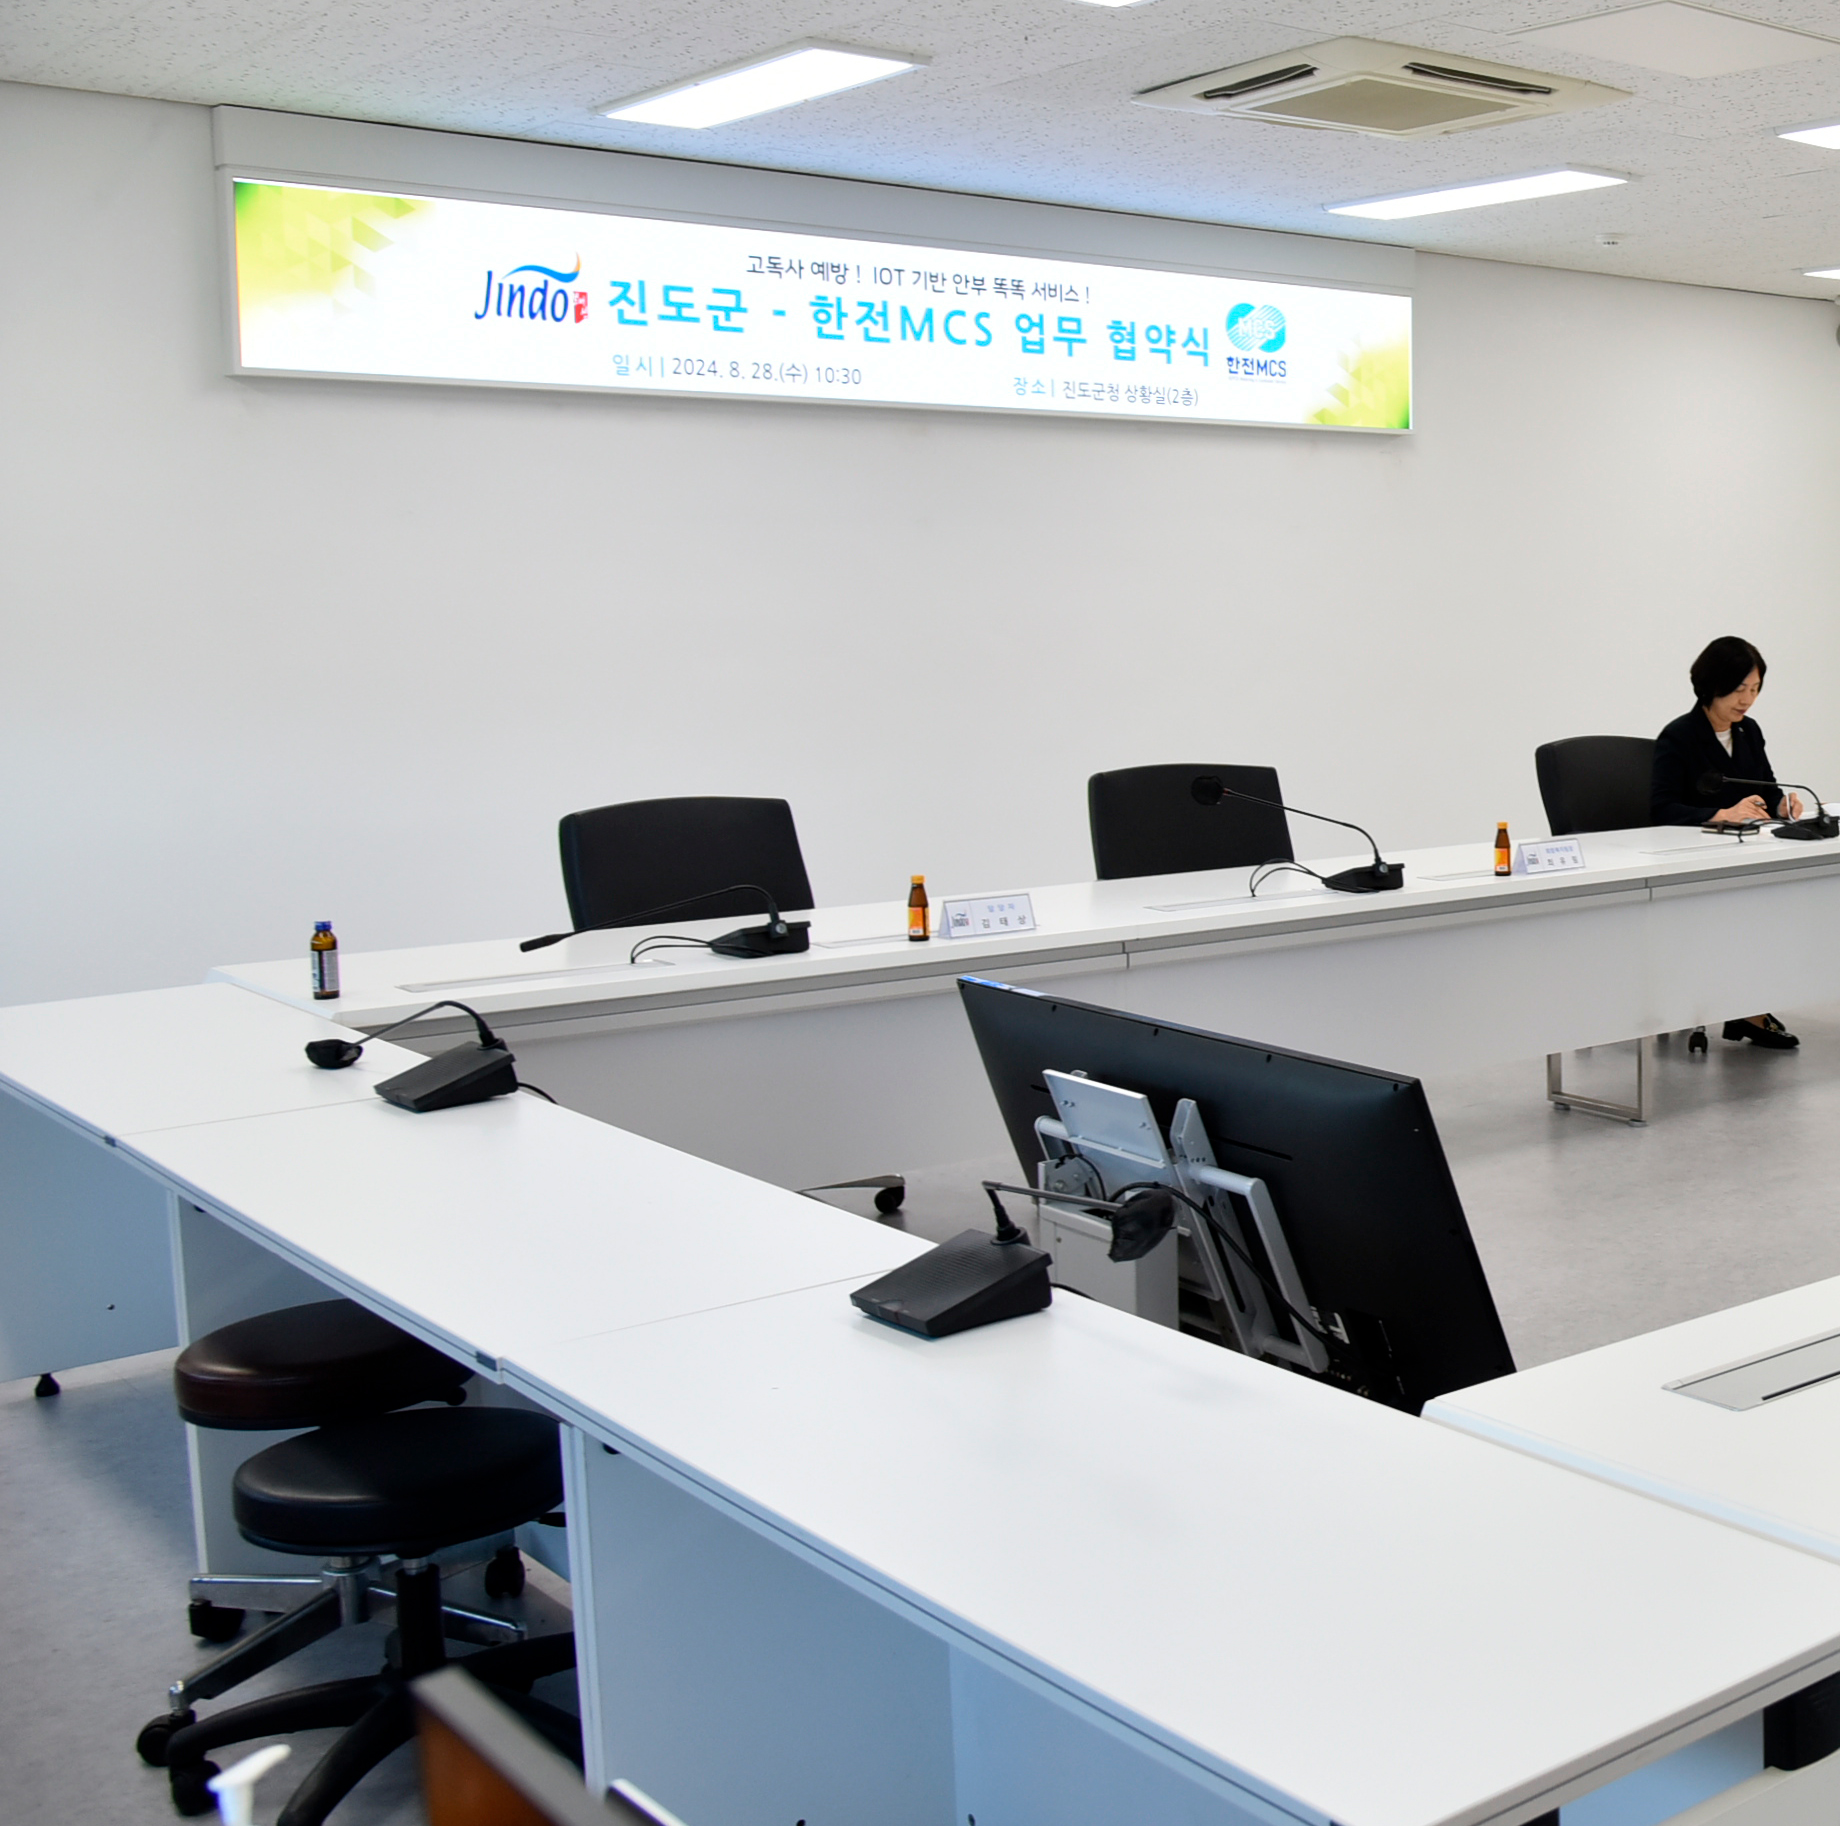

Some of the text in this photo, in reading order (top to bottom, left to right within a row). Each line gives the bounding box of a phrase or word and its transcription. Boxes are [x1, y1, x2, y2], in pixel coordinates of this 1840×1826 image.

[474, 270, 569, 322] Jindo
[746, 255, 804, 279] 고독사
[811, 262, 849, 285] 예방
[874, 267, 905, 286] IOT
[912, 271, 947, 293] 기반
[953, 274, 987, 295] 안부
[993, 278, 1025, 300] 똑똑
[1032, 282, 1079, 302] 서비스
[608, 280, 749, 333] 진도군
[809, 294, 993, 347] 한전MCS
[1015, 313, 1088, 357] 업무
[1106, 320, 1209, 367] 협약식
[673, 358, 722, 377] 2024.
[730, 361, 744, 379] 8.
[816, 367, 861, 384] 10:30
[1226, 356, 1286, 377] 한전MCS
[1064, 382, 1119, 402] 진도군청
